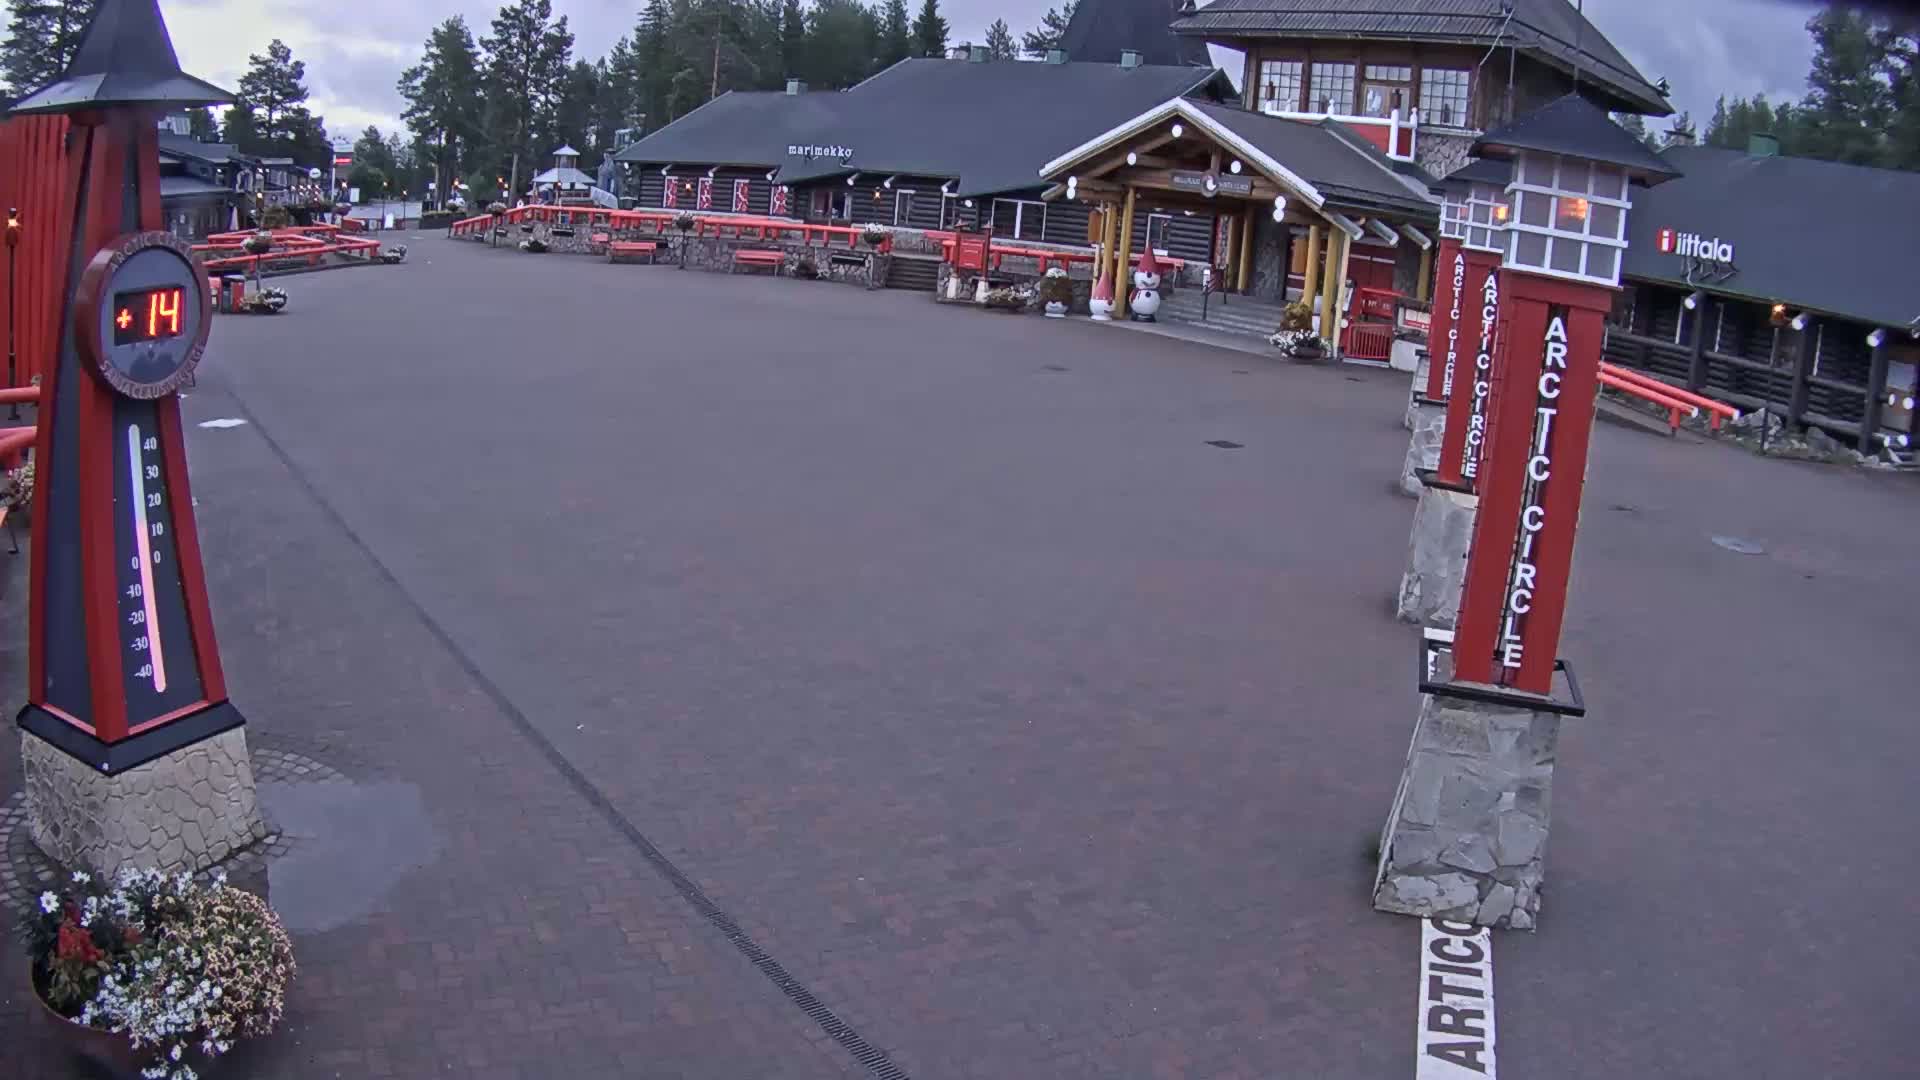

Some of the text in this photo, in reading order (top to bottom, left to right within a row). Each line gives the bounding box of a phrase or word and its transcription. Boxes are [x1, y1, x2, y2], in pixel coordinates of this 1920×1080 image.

[788, 144, 853, 158] marimekko
[1675, 231, 1733, 262] iittala
[149, 290, 180, 336] 14
[1442, 253, 1464, 396] ARCTIC CIRCLE
[1465, 274, 1497, 478] ARCTIC CIRCLE
[144, 437, 157, 451] 40
[145, 465, 159, 479] 30
[148, 492, 162, 507] 20
[1503, 316, 1568, 669] ARCTIC CIRCLE
[151, 521, 163, 537] 10
[131, 556, 139, 570] 0
[154, 550, 161, 564] 0
[126, 583, 142, 598] -10
[128, 610, 145, 625] -20
[131, 636, 149, 651] -30
[134, 664, 152, 678] -40
